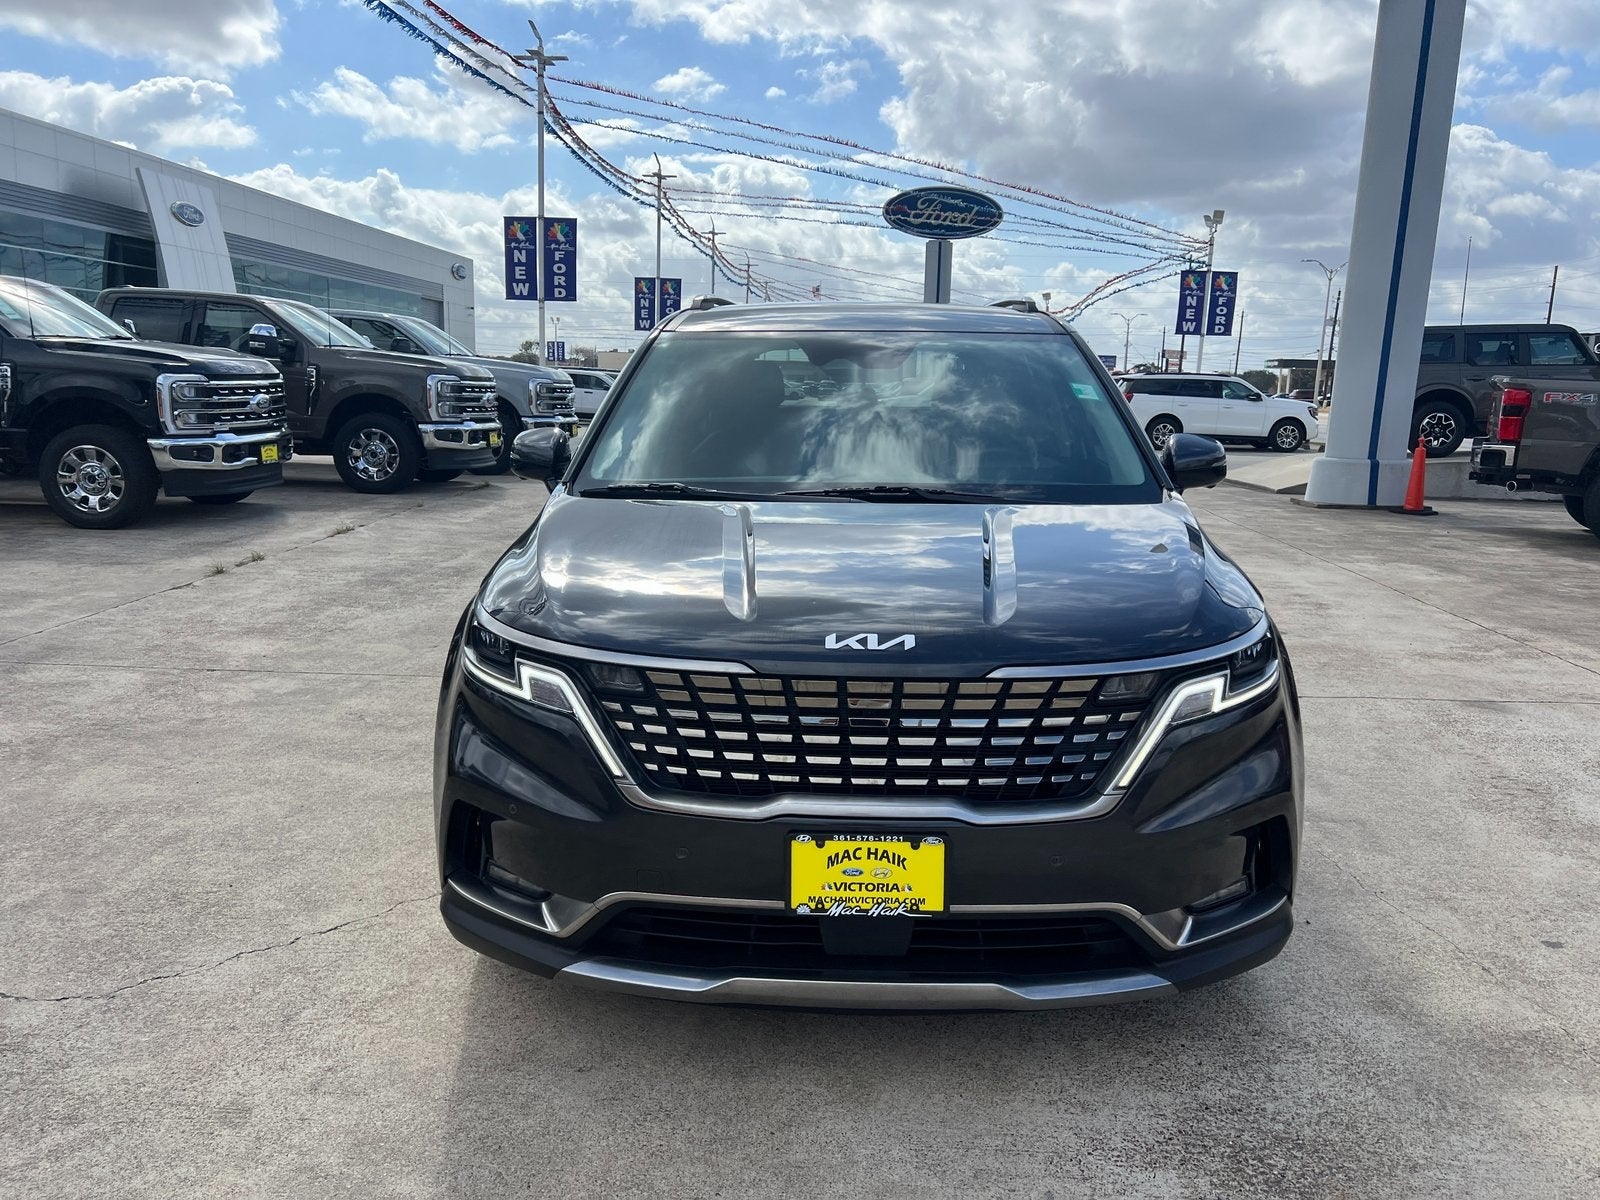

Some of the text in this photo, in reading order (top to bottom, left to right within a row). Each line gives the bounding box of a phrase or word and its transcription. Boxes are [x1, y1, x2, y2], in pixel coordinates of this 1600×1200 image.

[909, 196, 979, 227] Ford
[512, 249, 530, 296] NEW
[552, 251, 567, 298] FORD
[639, 298, 651, 329] NEW
[665, 300, 675, 315] FO
[1182, 296, 1197, 332] NEW
[1214, 297, 1228, 334] FORD
[1543, 392, 1595, 403] FX4
[824, 632, 916, 651] KIA
[833, 834, 904, 842] 361-576-1221
[826, 847, 908, 871] MAC HAIK
[833, 881, 901, 893] VICTORIA
[827, 901, 910, 918] Mac Haik
